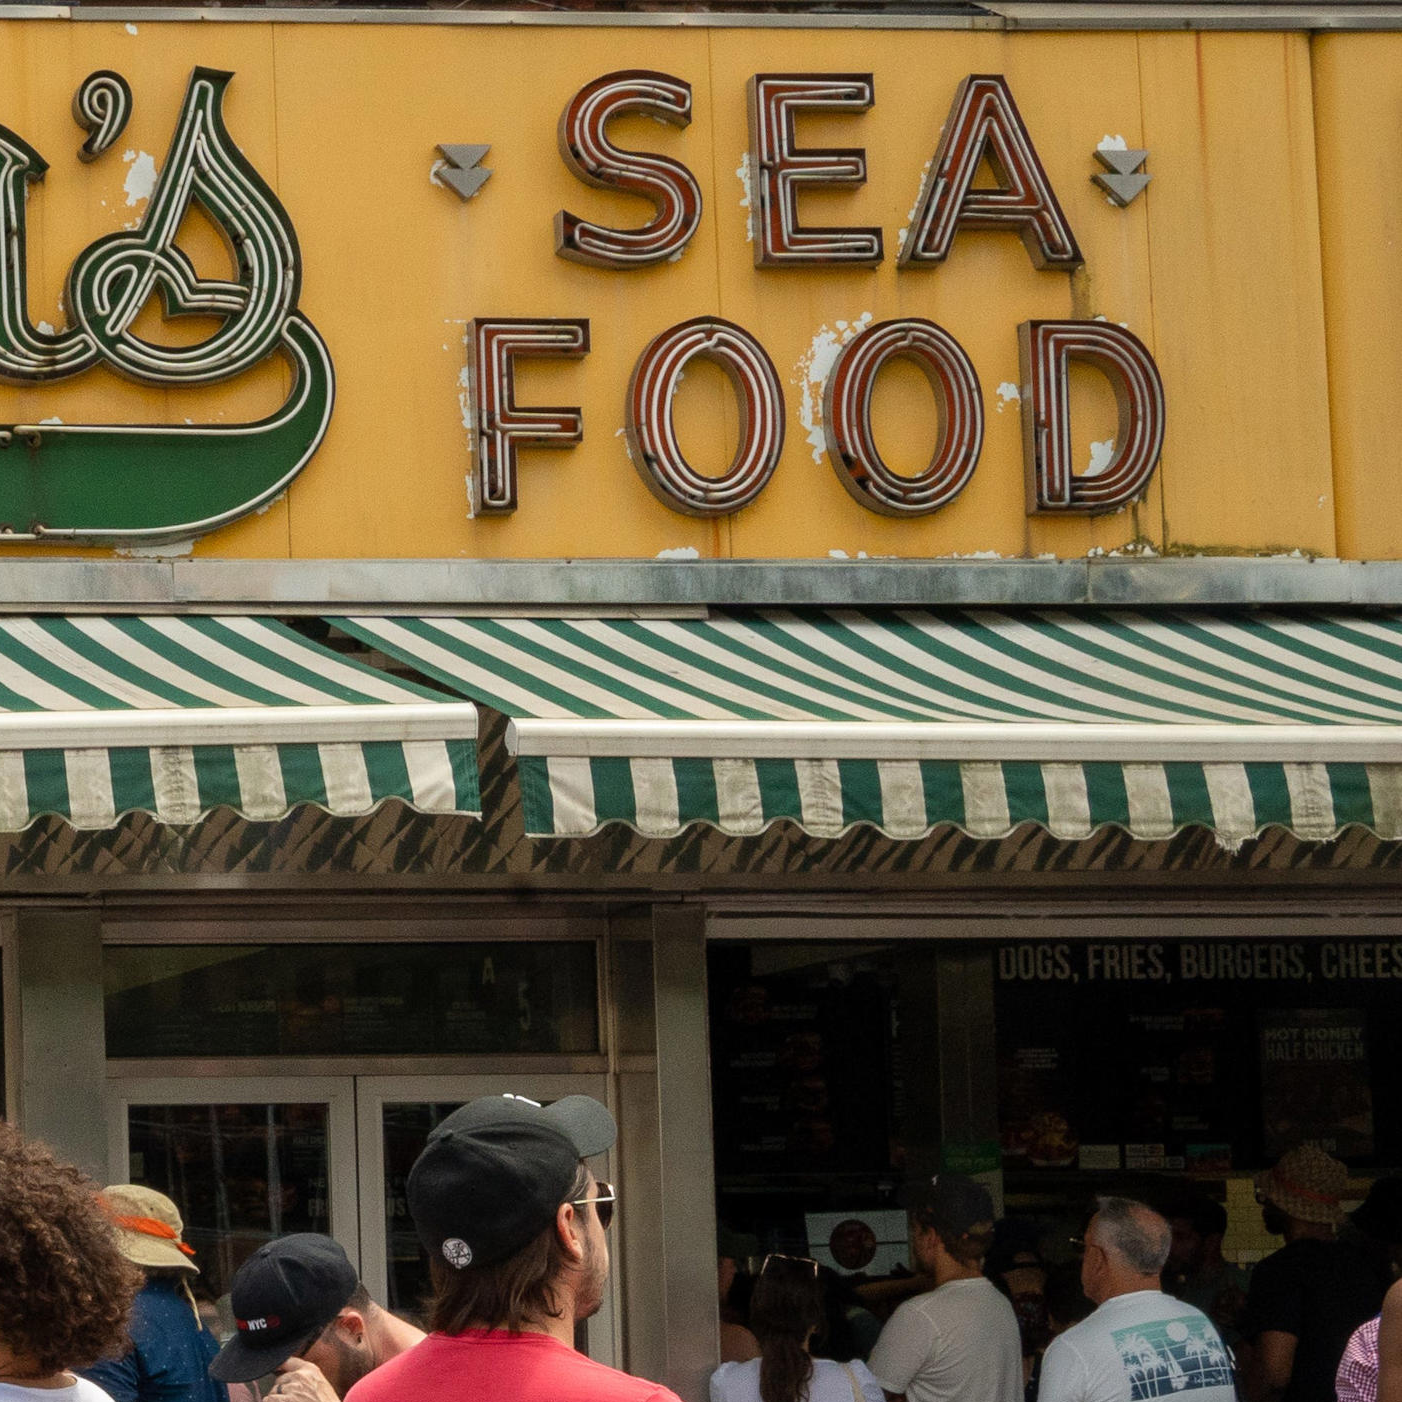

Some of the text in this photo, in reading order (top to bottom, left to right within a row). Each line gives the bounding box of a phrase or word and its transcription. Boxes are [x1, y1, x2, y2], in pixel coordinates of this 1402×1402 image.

[555, 69, 1085, 270] SEA
[467, 316, 1165, 517] FOOD
[998, 944, 1078, 984] DOGS,
[1087, 944, 1172, 984] FRIES,
[1181, 944, 1313, 984] BURGERS,
[1262, 1027, 1299, 1040] HOT
[247, 1318, 267, 1331] NYC
